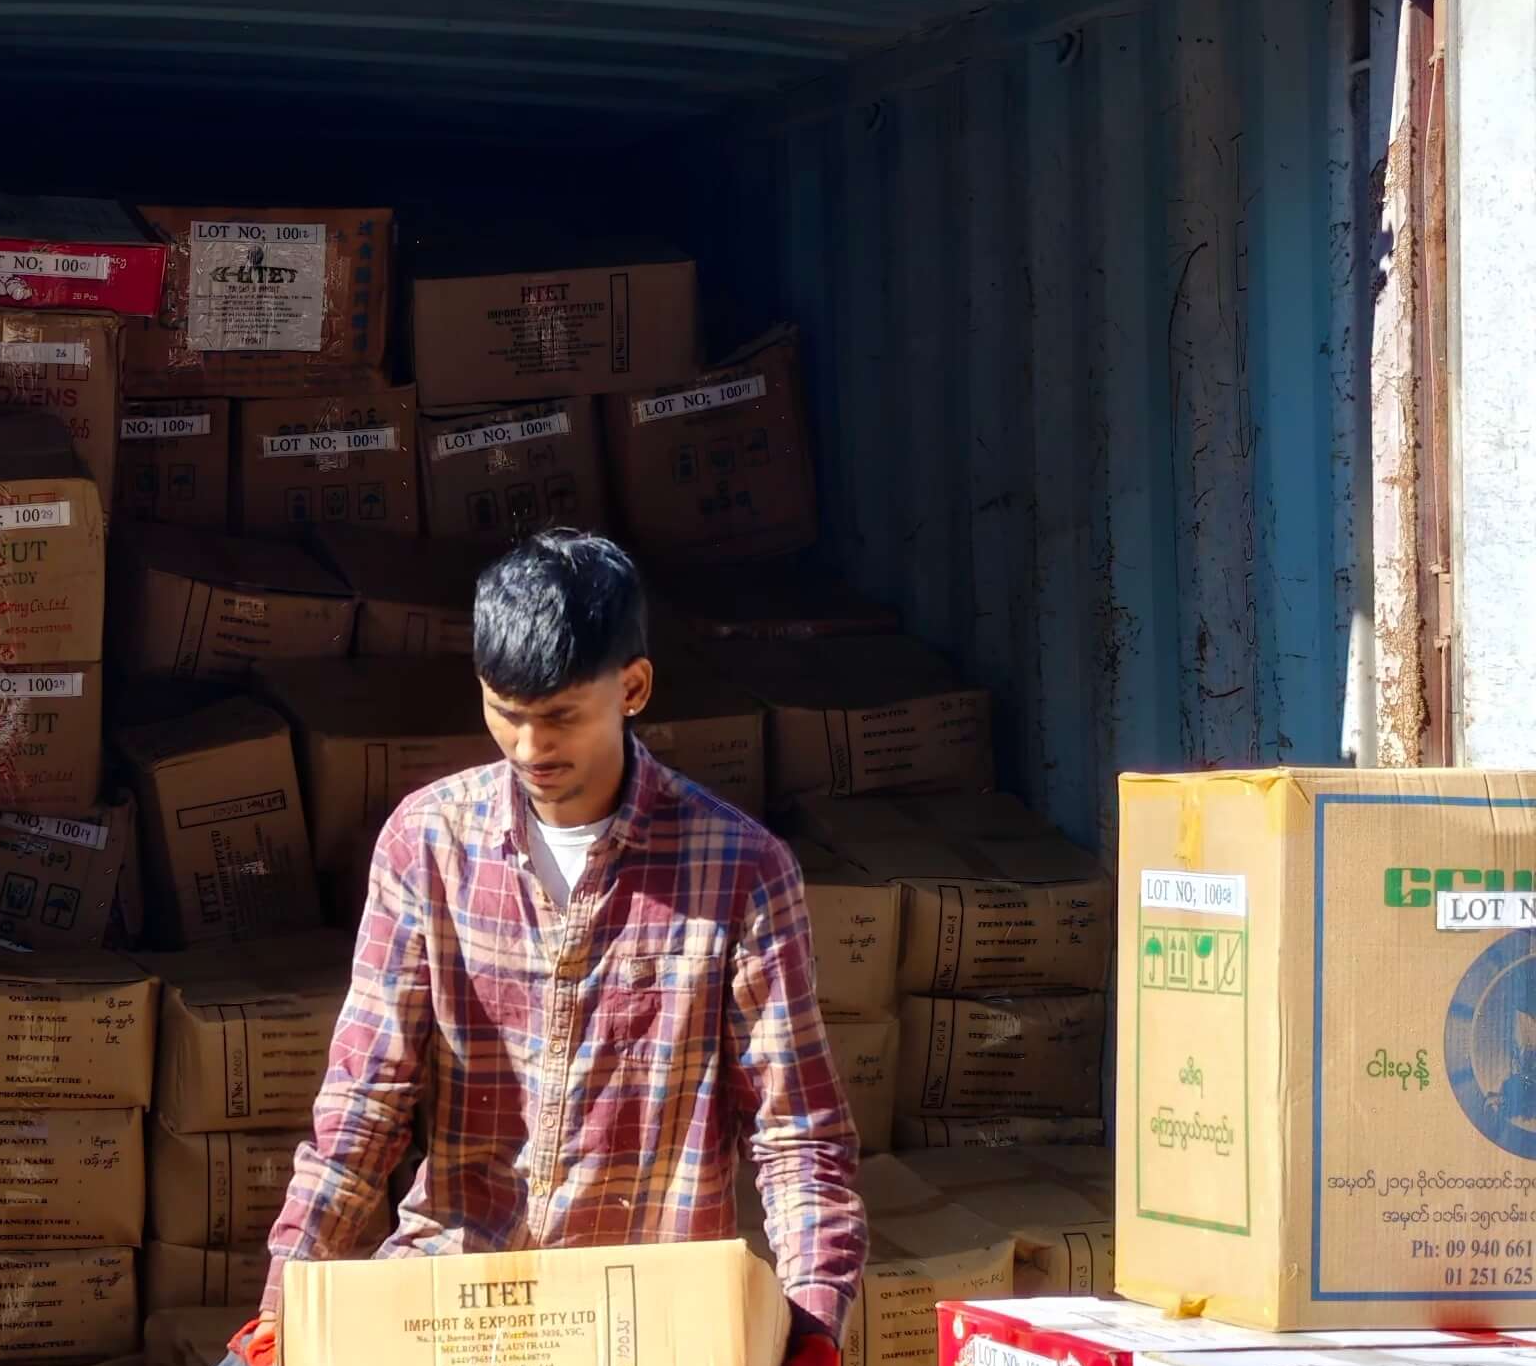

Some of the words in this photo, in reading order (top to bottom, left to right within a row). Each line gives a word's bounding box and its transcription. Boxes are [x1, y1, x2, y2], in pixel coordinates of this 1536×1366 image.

[198, 224, 229, 238] LOT
[13, 256, 44, 271] NO;
[644, 401, 675, 417] LOT
[125, 421, 153, 434] NO;
[270, 439, 300, 452] LOT
[310, 438, 337, 451] NO;
[445, 434, 474, 450] LOT
[1146, 877, 1169, 899] LOT
[1450, 897, 1505, 921] LOT
[1411, 1239, 1440, 1259] Ph:
[1445, 1240, 1465, 1259] 09
[1469, 1240, 1501, 1258] 940
[1504, 1240, 1533, 1258] 661
[1444, 1266, 1465, 1286] 01
[1470, 1266, 1500, 1285] 251
[1503, 1266, 1533, 1285] 625
[458, 1280, 538, 1309] HTET
[881, 1286, 934, 1300] QUANTITY
[404, 1317, 459, 1333] IMPORT
[464, 1317, 475, 1330] &
[480, 1313, 536, 1330] EXPORT
[540, 1311, 568, 1327] PTY
[572, 1310, 597, 1325] LTD
[881, 1348, 935, 1360] IMPORTER
[977, 1348, 996, 1366] LOT
